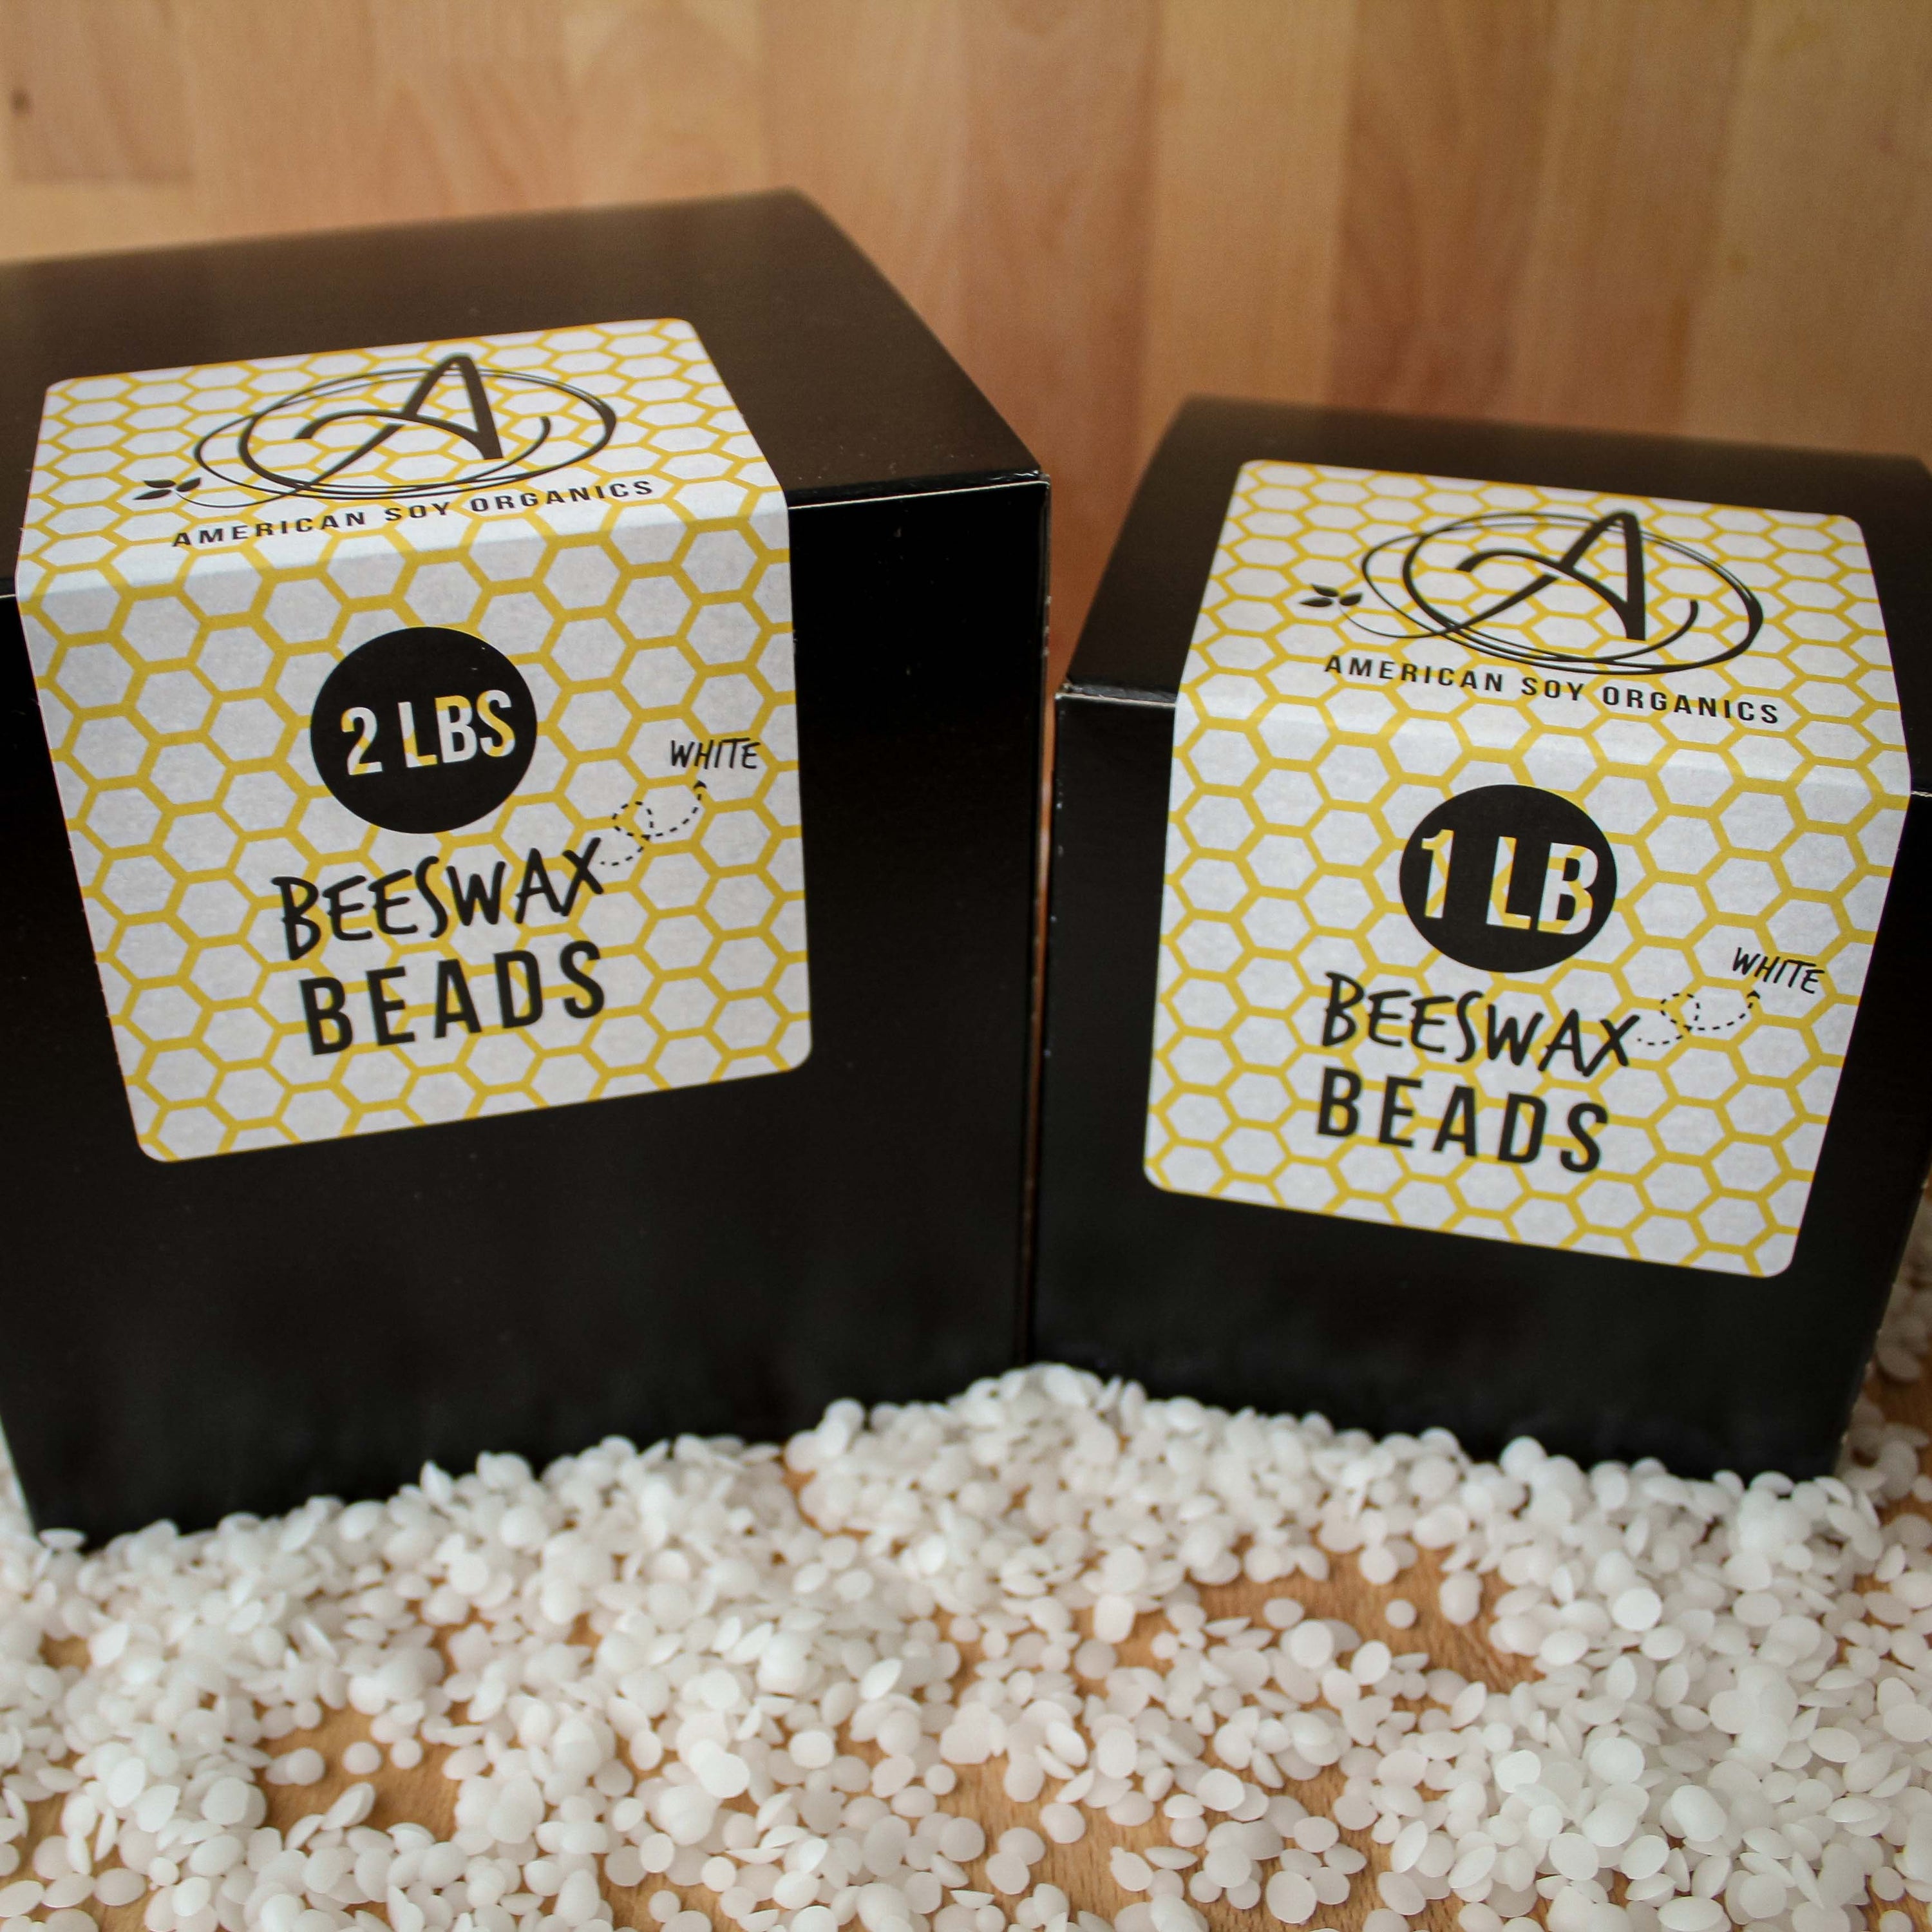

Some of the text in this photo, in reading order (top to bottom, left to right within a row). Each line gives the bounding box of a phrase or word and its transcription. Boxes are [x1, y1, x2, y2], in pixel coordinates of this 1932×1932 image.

[171, 480, 654, 547] AMERICAN SOY ORGANICS
[341, 690, 516, 776] 2 LBS
[1323, 654, 1780, 724] AMERICAN SOY ORGANICS
[670, 737, 762, 770] WHITE
[271, 837, 605, 960] BEESWAX
[1421, 829, 1600, 935] 1 LB
[299, 941, 605, 1056] BEADS
[1731, 947, 1826, 994] WHITE
[1322, 971, 1640, 1077] BEESWAX
[1316, 1067, 1609, 1174] BEADS
